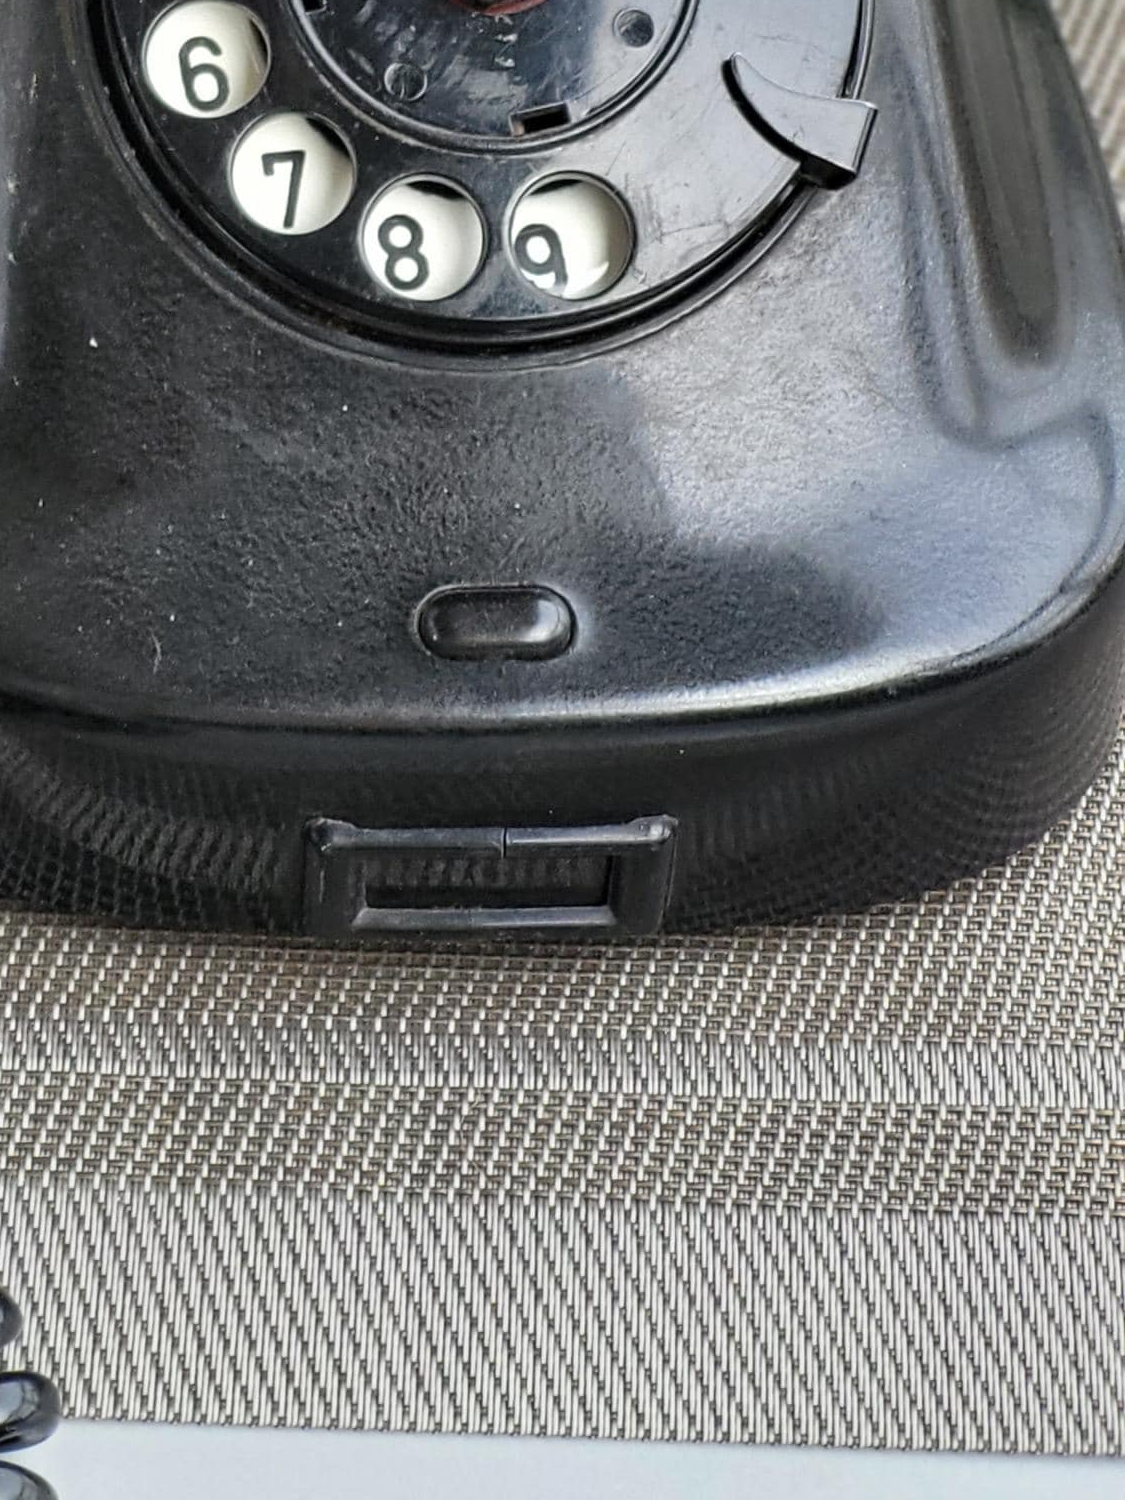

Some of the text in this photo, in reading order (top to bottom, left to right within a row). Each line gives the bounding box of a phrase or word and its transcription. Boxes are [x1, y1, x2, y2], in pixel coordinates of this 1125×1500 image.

[178, 35, 231, 112] 6
[261, 150, 306, 229] 7
[377, 213, 430, 291] 8
[513, 223, 568, 292] 9
